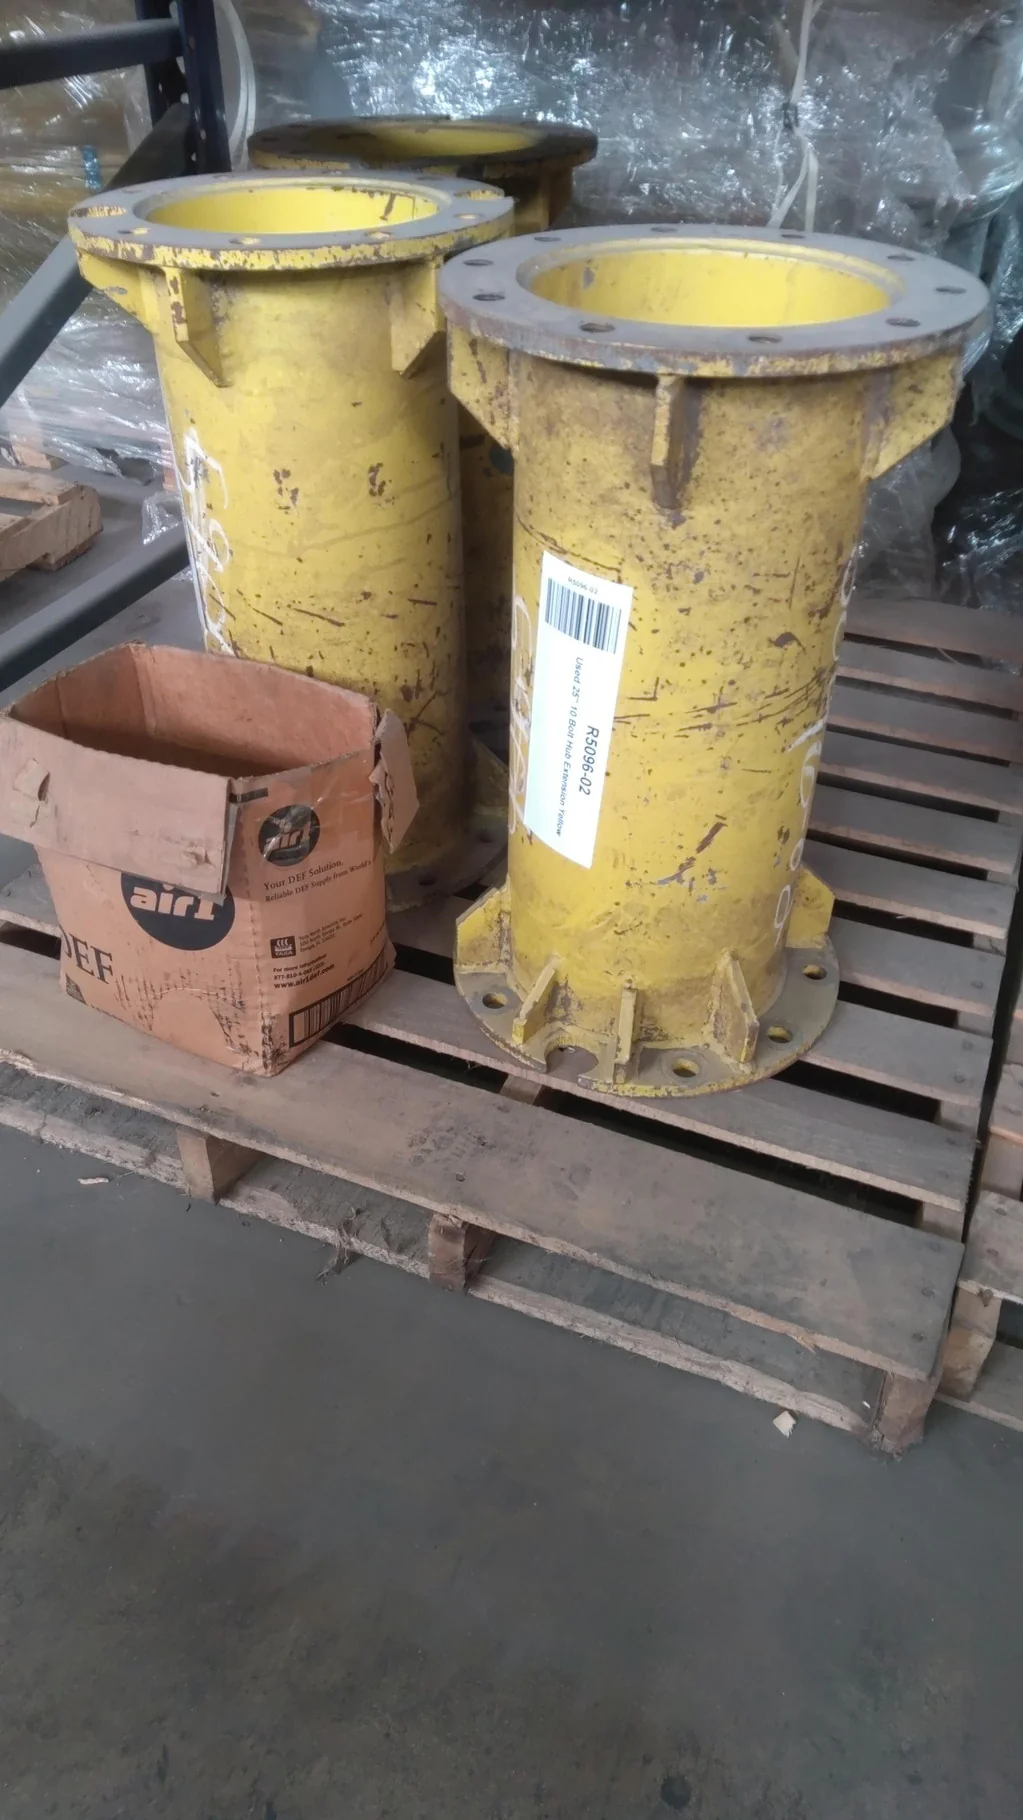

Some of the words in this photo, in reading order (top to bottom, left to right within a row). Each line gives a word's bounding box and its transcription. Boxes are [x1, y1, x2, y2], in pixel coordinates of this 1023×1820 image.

[573, 656, 584, 684] Used
[569, 705, 577, 717] 10
[566, 718, 577, 739] Bolt
[564, 740, 574, 760] Hub
[578, 725, 600, 796] R5096-02
[559, 761, 572, 806] Extension
[556, 808, 566, 837] Yellow
[263, 879, 287, 891] Your
[287, 871, 308, 885] DEF
[308, 860, 344, 878] Solution.
[265, 889, 294, 903] Reliable
[294, 882, 310, 894] DEF
[310, 874, 333, 889] Supply
[332, 868, 349, 881] from
